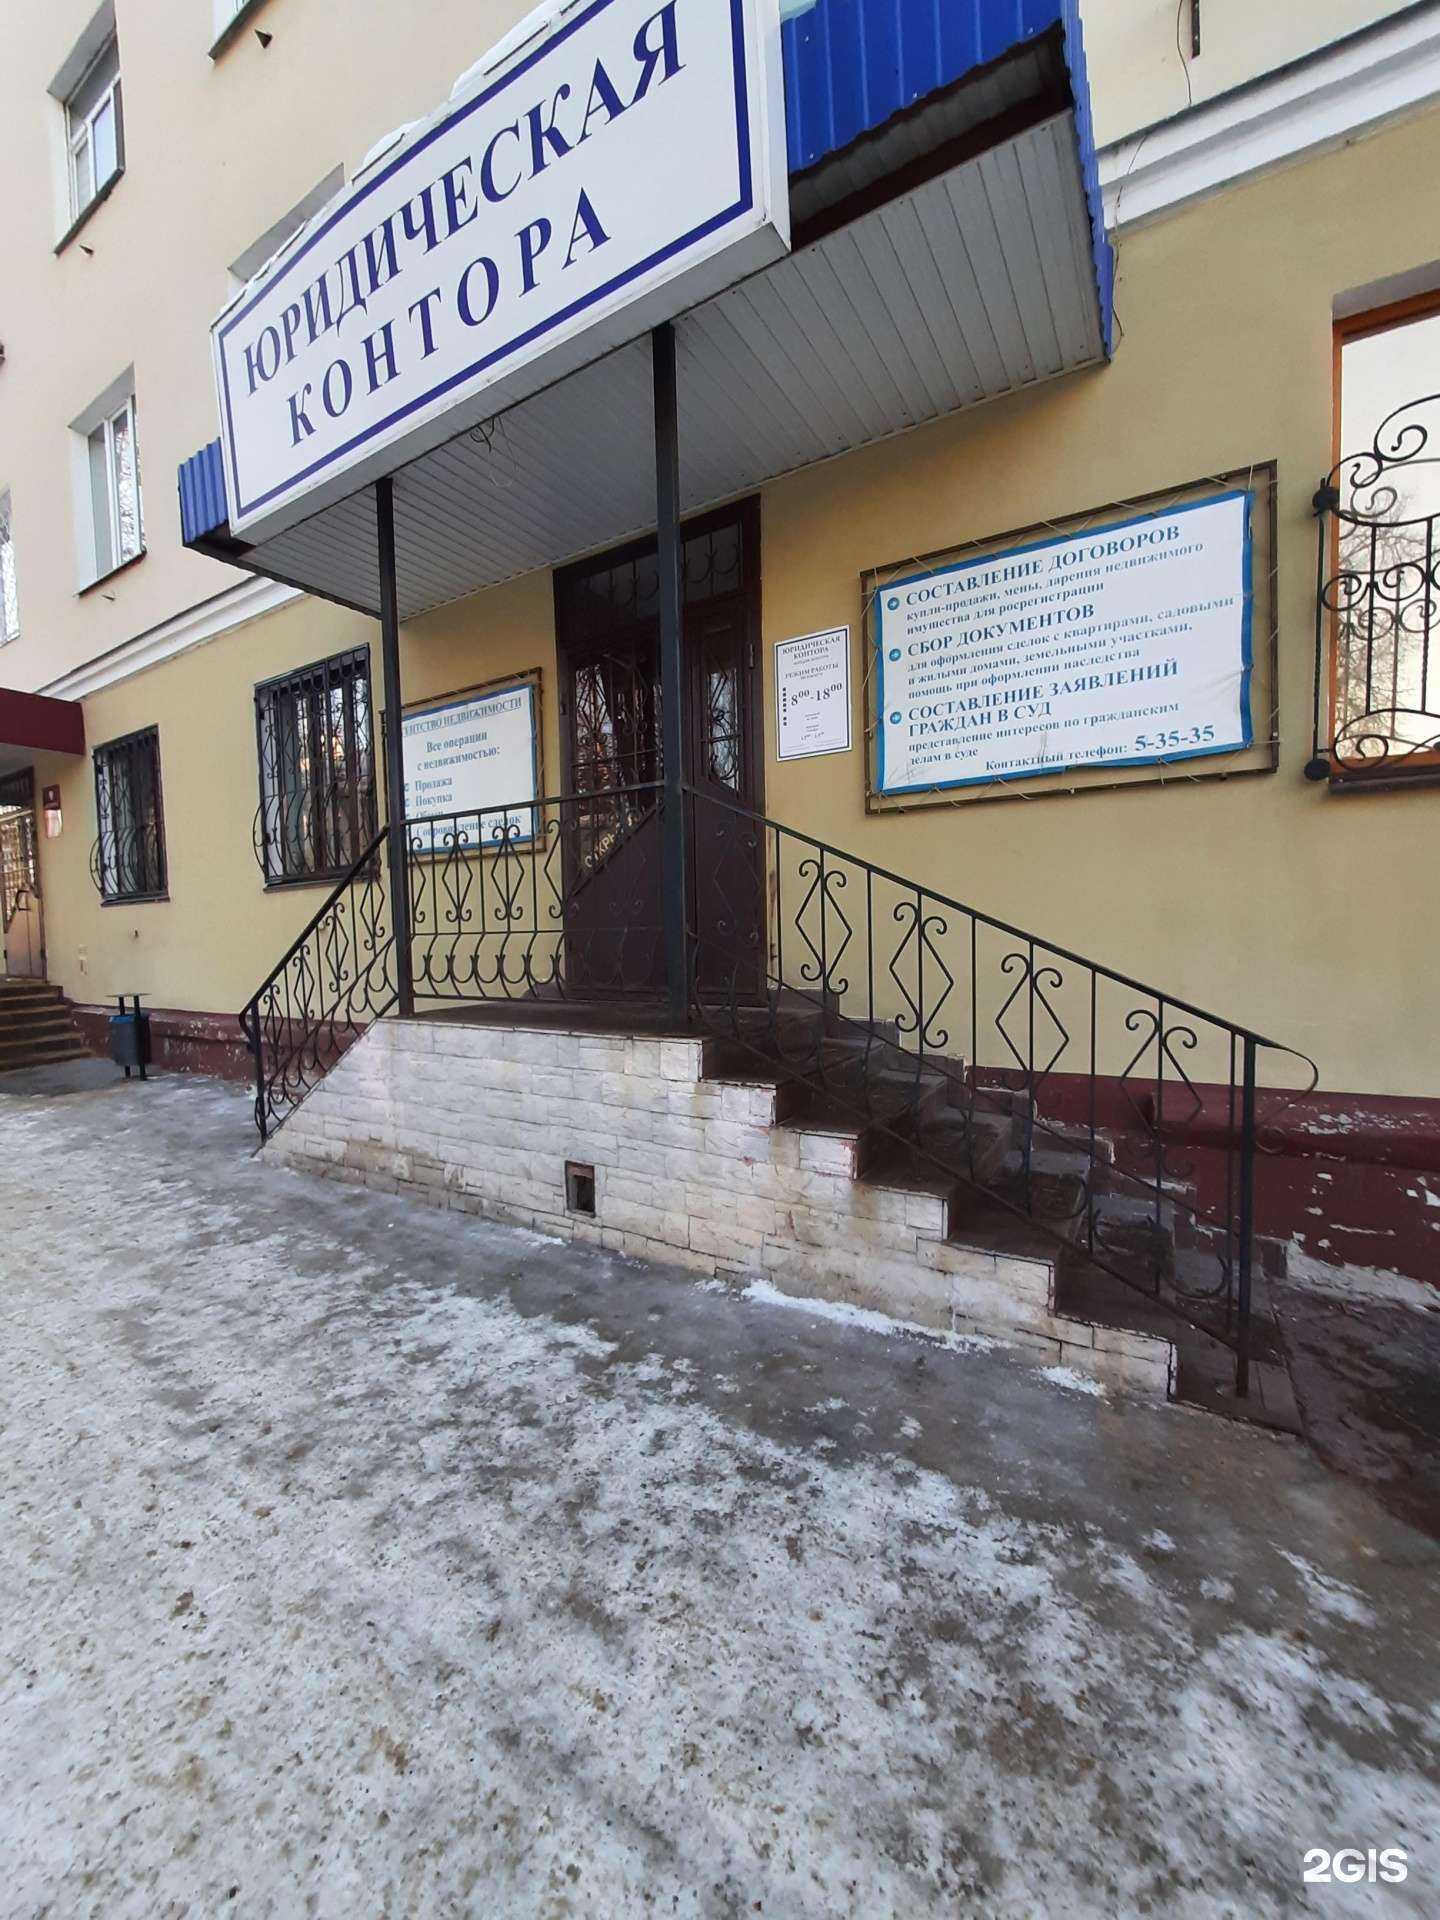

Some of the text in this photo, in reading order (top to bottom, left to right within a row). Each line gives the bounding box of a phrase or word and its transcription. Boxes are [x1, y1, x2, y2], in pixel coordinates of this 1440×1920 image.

[243, 0, 687, 396] ЮРИДИЧЕСКАЯ
[287, 186, 611, 448] КОНТОРА
[906, 525, 1179, 606] СОСТАВЛЕНИЕ ДОГОВОРОВ
[906, 592, 1000, 621] купли-продажи,
[1046, 567, 1100, 590] дарения
[1105, 543, 1204, 573] недвижимого
[906, 582, 1104, 636] имущества для росрегистрации
[907, 603, 1094, 657] СБОР ДОКУМЕНТОВ
[908, 661, 927, 673] для
[930, 645, 1004, 670] оформления
[1007, 634, 1050, 652] сделок
[1053, 633, 1060, 642] с
[1157, 597, 1234, 620] садовыми
[908, 677, 915, 686] и
[917, 668, 967, 684] жилыми
[1023, 638, 1106, 662] земельными
[908, 650, 1140, 701] помощь при оформлении наследства
[443, 696, 521, 725] НЕДВИЖИМОСТИ
[908, 657, 1178, 722] СОСТАВЛЕНИЕ ЗАЯВЛЕНИЙ
[426, 731, 488, 753] Все операции
[909, 701, 1052, 737] ГРАЖДАН В СУД
[909, 702, 1179, 753] представление интересов по гражданским
[417, 746, 500, 771] с недвижимостью:
[911, 748, 978, 767] делам в суде
[985, 724, 1216, 771] Контактный телефон: 5-35-35
[415, 777, 452, 792] Продажа
[415, 794, 452, 808] Покупка
[488, 815, 521, 829] сдеок
